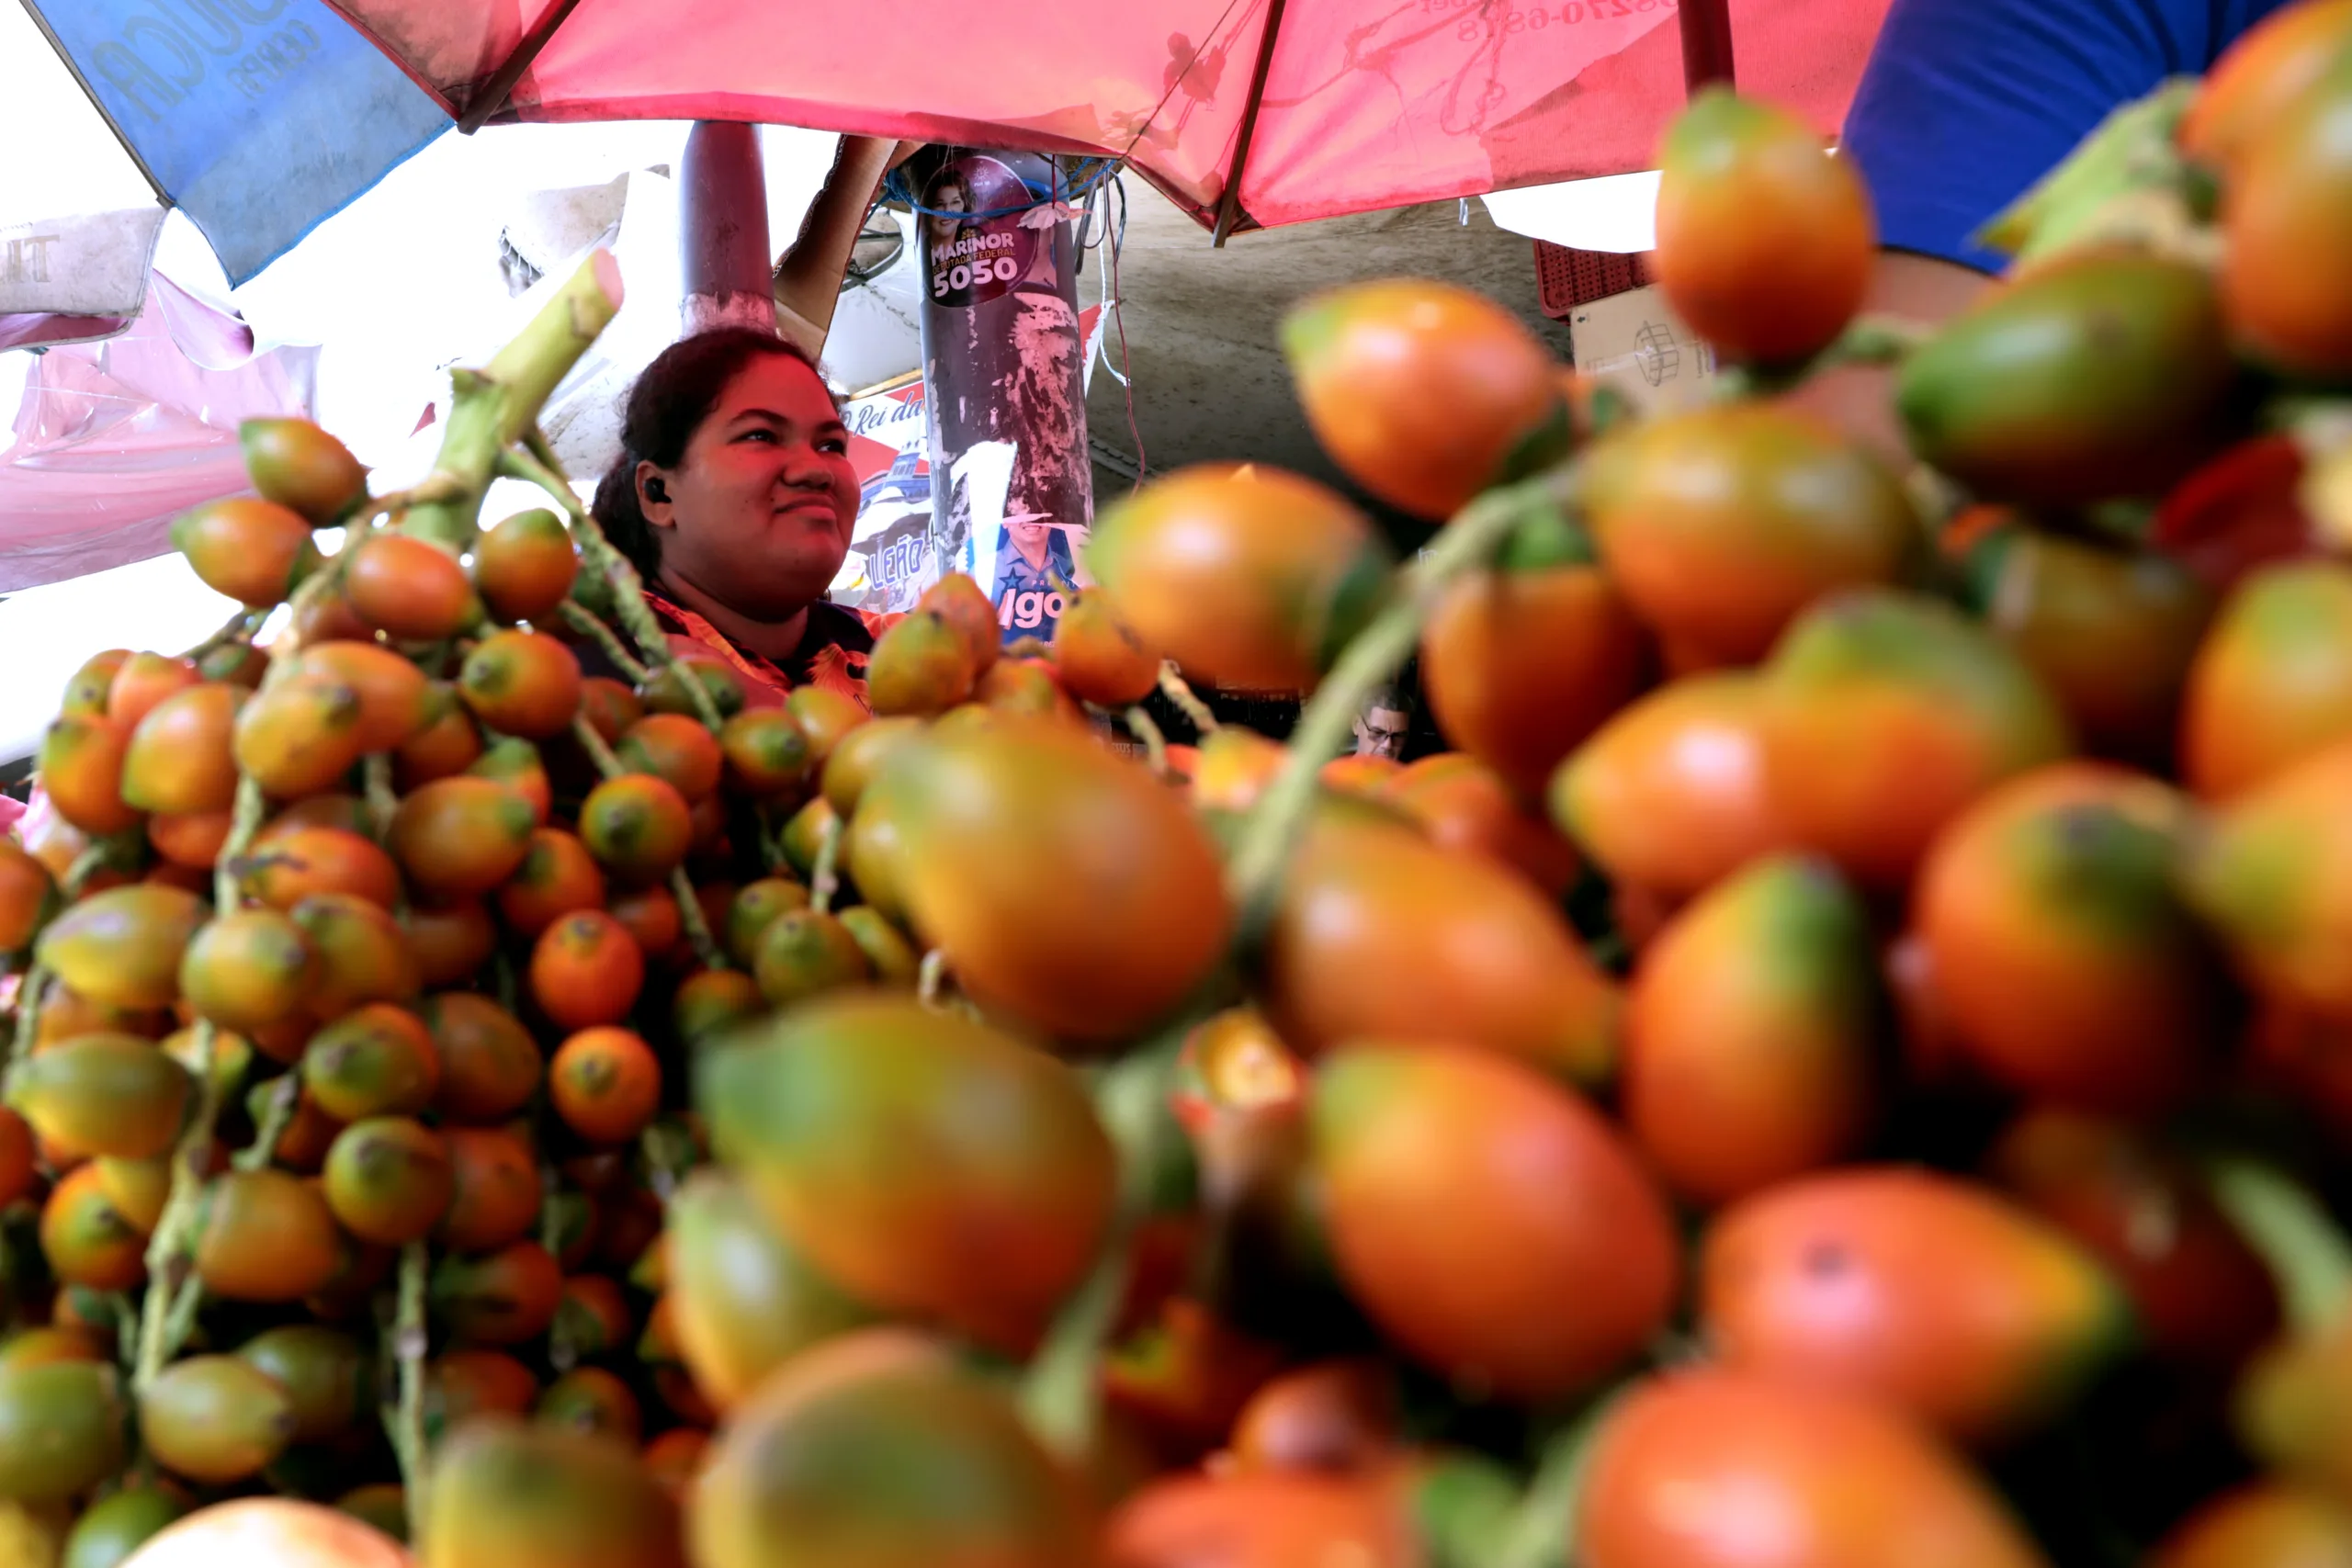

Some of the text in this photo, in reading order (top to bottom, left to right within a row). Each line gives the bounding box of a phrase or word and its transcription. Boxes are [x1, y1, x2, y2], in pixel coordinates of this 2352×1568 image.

[931, 232, 1014, 266] MARINOR
[933, 247, 1016, 275] DEPUTADA FEDERAL
[933, 256, 1018, 298] 5050
[852, 404, 887, 437] Rei
[891, 391, 924, 423] da
[869, 534, 925, 591] LEÃO
